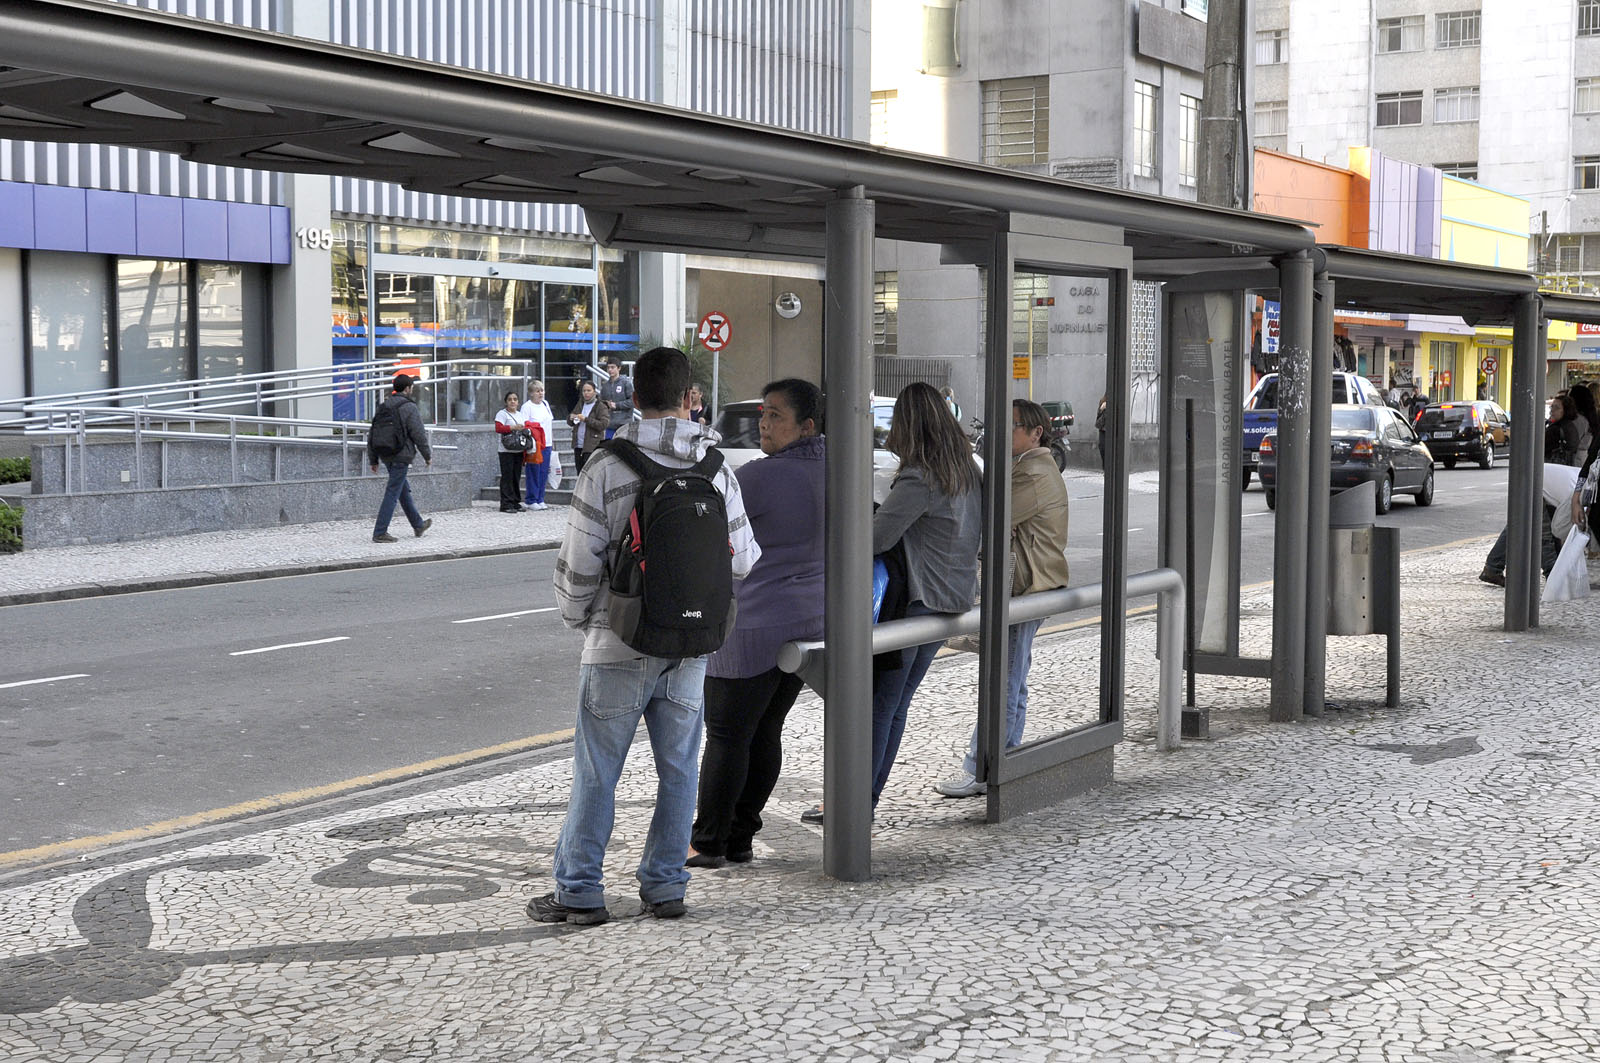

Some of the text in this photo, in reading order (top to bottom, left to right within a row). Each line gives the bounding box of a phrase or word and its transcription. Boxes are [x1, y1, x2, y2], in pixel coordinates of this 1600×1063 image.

[296, 227, 333, 250] 195
[1070, 286, 1100, 297] CASA
[1078, 305, 1094, 315] DO
[1221, 338, 1232, 485] JARDIM SOCIAL/BATEL
[682, 610, 702, 619] Jeep
